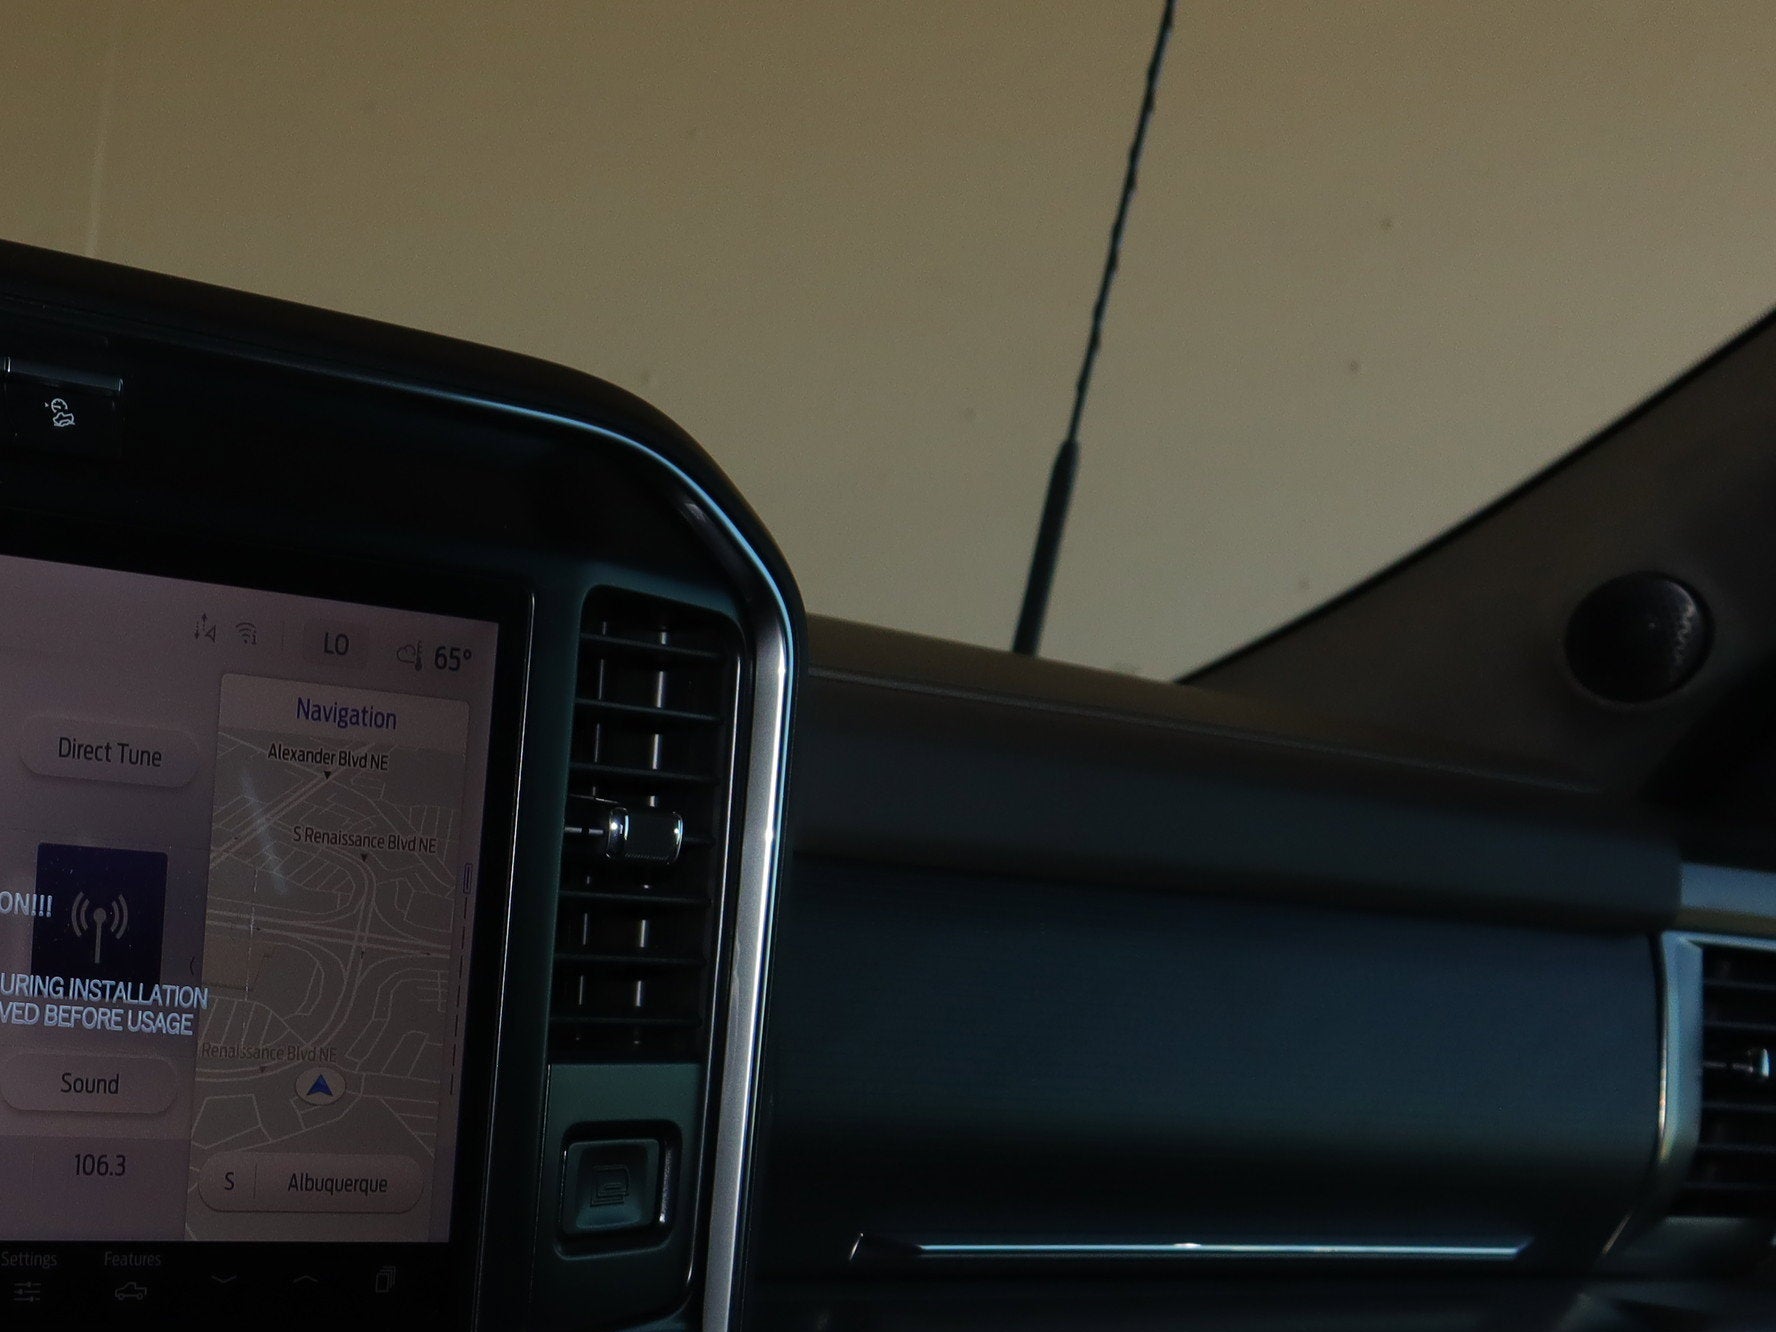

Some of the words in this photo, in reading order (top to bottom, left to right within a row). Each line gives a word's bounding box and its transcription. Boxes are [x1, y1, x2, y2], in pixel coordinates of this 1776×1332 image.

[324, 631, 350, 656] LO
[433, 644, 473, 671] 65°
[296, 697, 398, 731] Navigation
[58, 737, 112, 763] Direct
[117, 742, 163, 768] Tune
[268, 743, 336, 765] Alexander
[338, 750, 368, 769] Blvd
[370, 754, 389, 770] NE
[293, 826, 302, 842] S
[305, 827, 385, 849] Renaissance
[388, 834, 416, 852] Blvd
[419, 838, 437, 853] NE
[69, 976, 209, 1010] INSTALLATION
[44, 1003, 124, 1032] BEFORE
[127, 1009, 195, 1036] USAGE
[287, 1045, 317, 1062] Blvd
[319, 1047, 337, 1062] NE
[60, 1072, 120, 1095] Sound
[73, 1154, 126, 1177] 106.3
[224, 1172, 235, 1191] S
[288, 1172, 388, 1196] Albuquerque
[0, 1250, 58, 1271] Settings
[104, 1251, 162, 1268] Features
